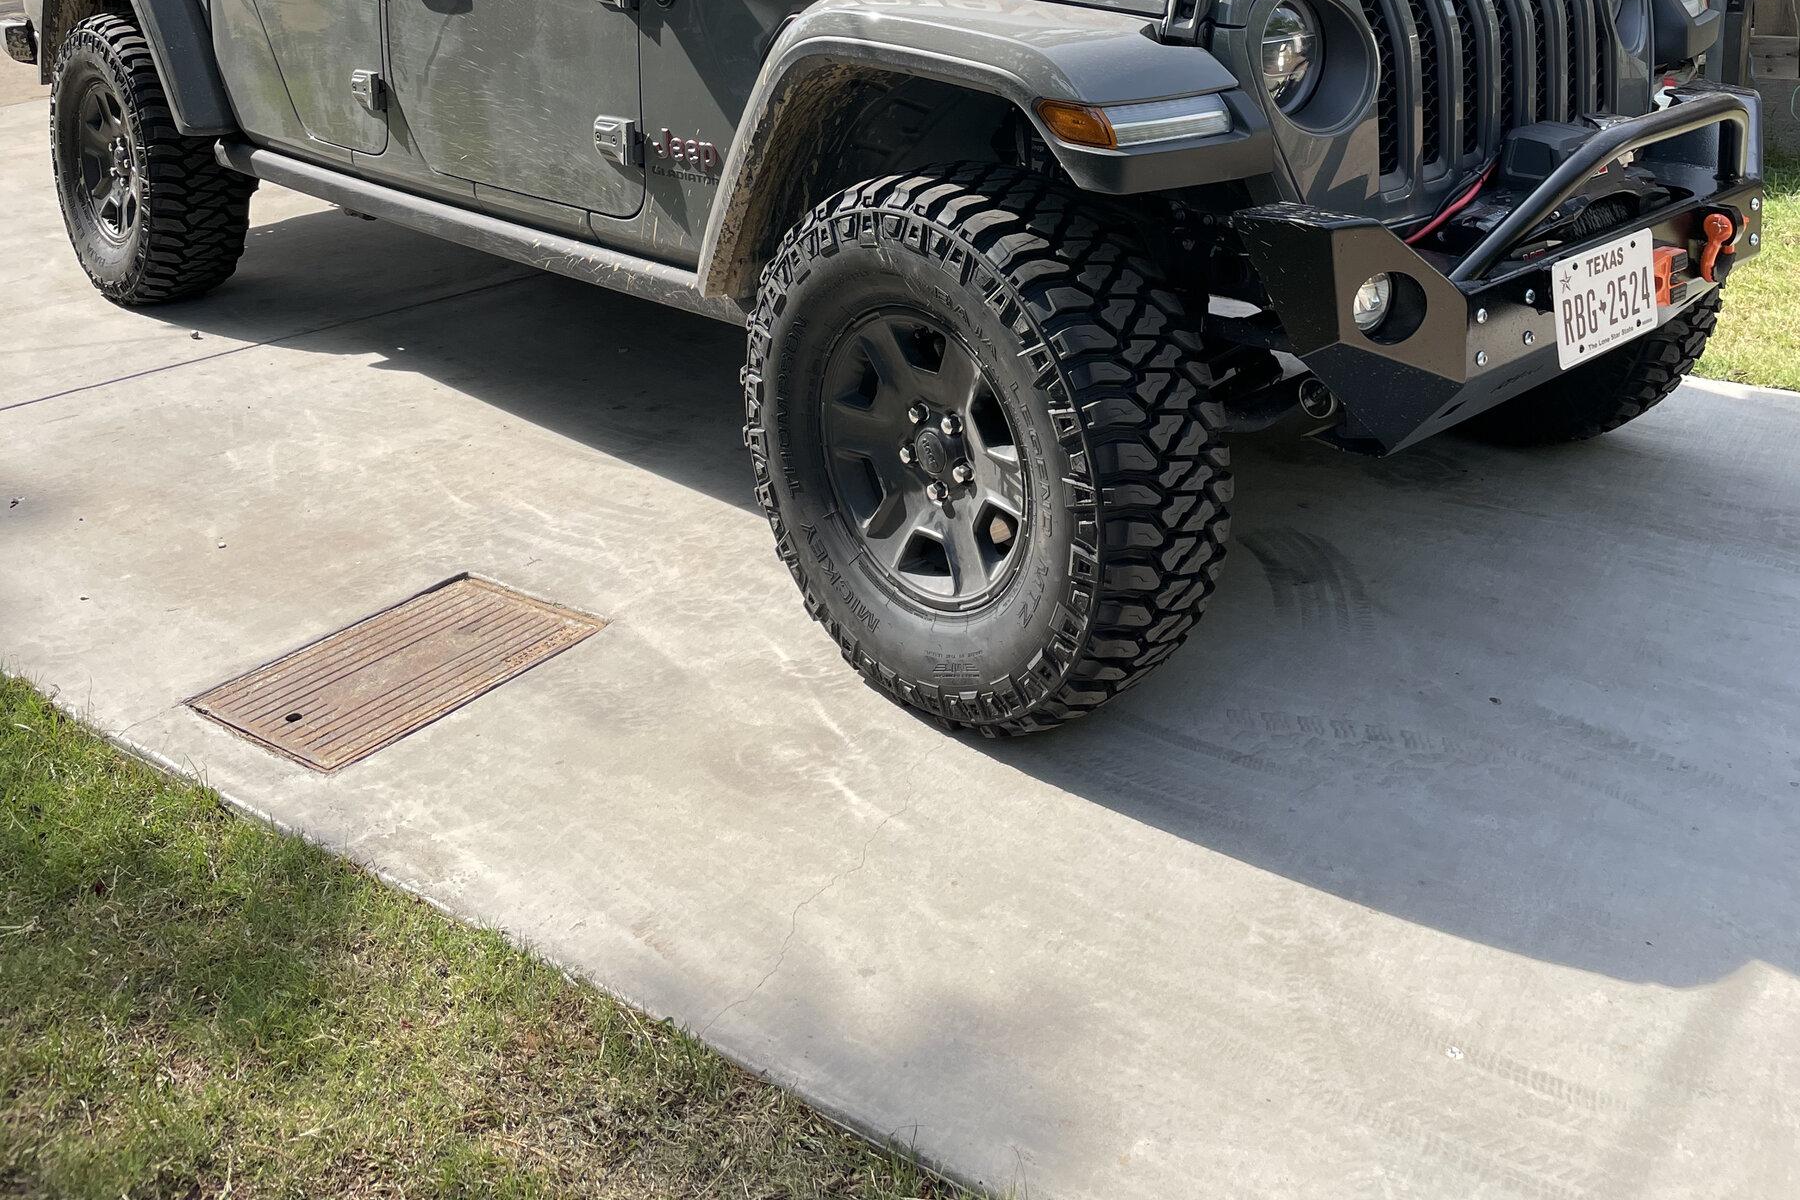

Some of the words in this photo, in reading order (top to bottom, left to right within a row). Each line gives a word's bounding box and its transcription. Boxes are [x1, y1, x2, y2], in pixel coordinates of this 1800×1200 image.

[652, 128, 718, 172] Jeep
[1586, 247, 1624, 277] TEXAS
[1562, 289, 1598, 346] RBG
[1606, 266, 1651, 326] 2524
[1588, 342, 1598, 350] The
[1598, 336, 1611, 346] Lone
[1611, 331, 1621, 341] Star
[1621, 326, 1634, 336] State
[777, 313, 808, 497] THOMPSON
[934, 285, 998, 363] BAJA
[1010, 381, 1053, 538] LEGEND
[800, 520, 880, 633] MICKEY
